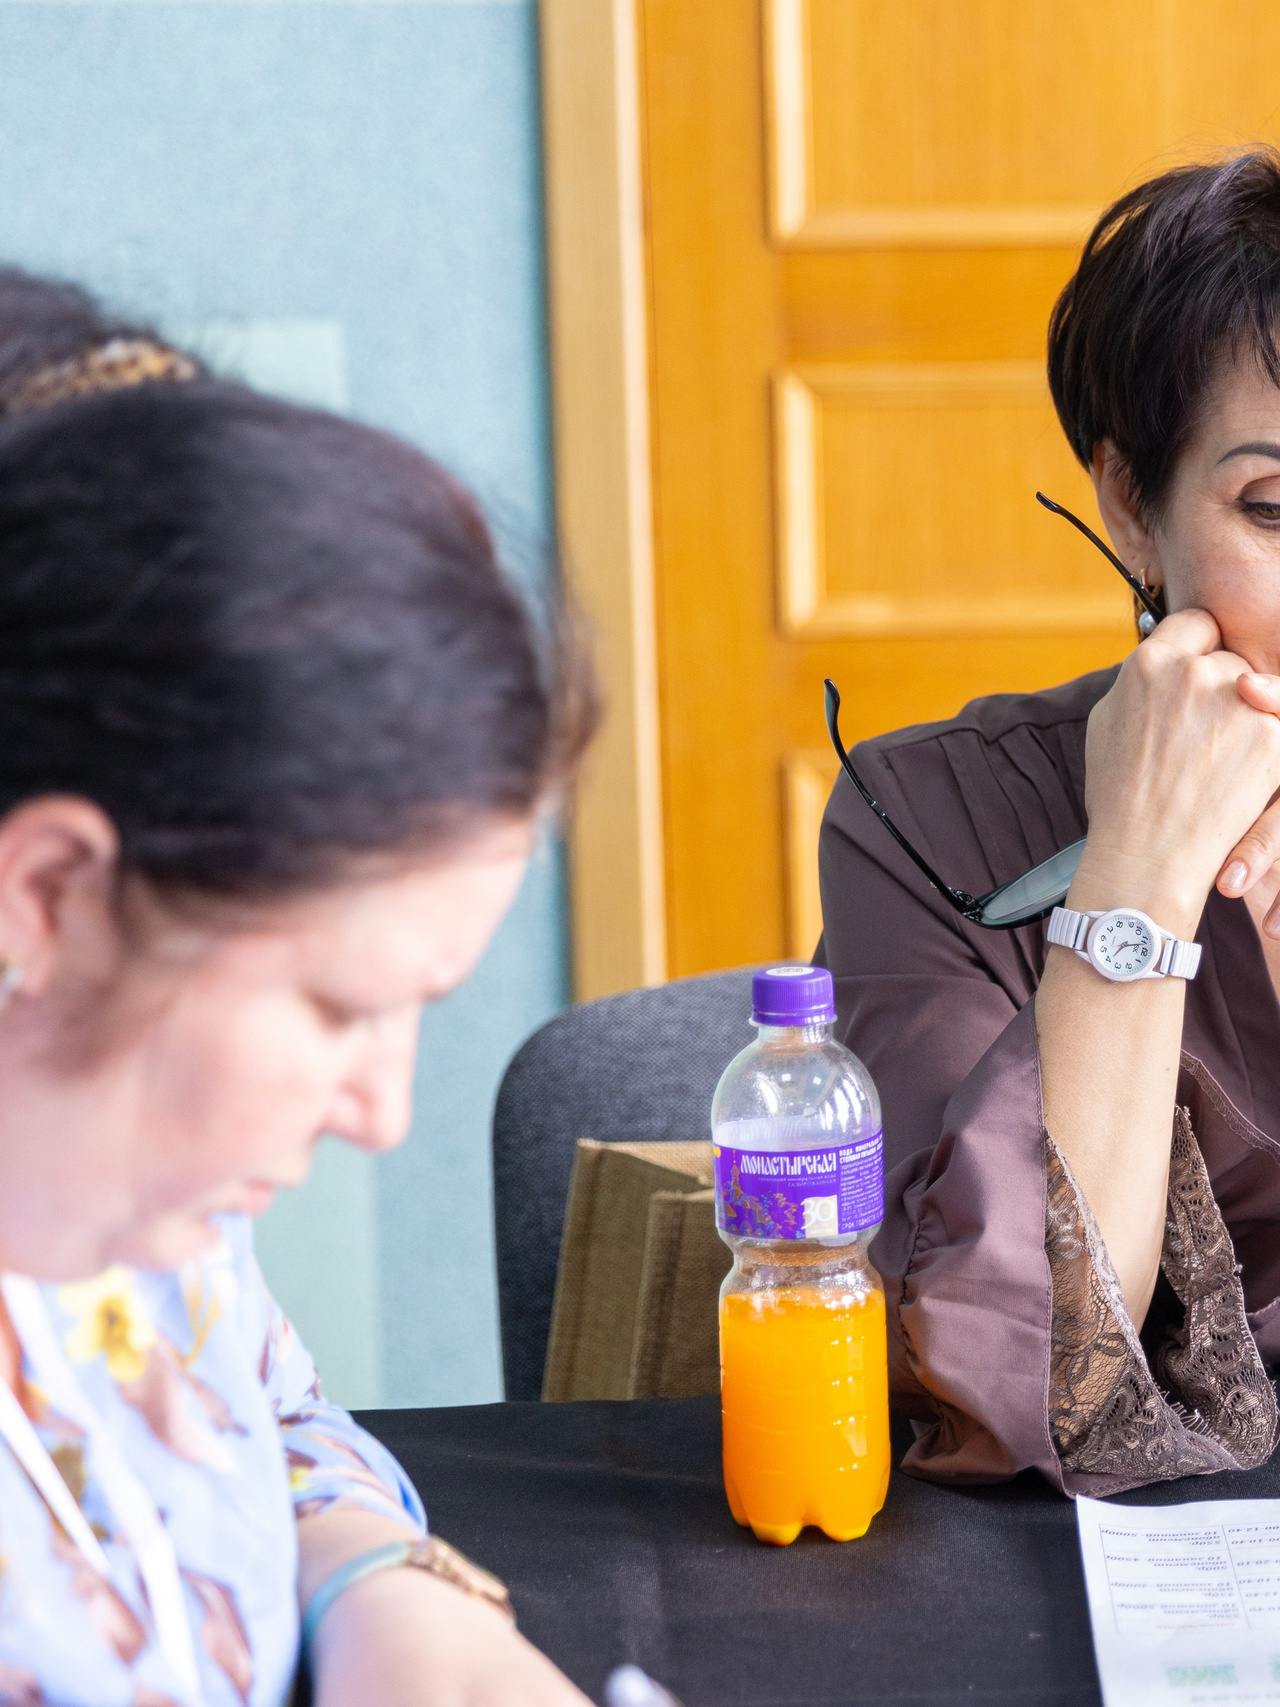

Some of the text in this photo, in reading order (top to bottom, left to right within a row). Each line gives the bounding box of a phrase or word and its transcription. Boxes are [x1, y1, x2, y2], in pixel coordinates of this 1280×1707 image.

[741, 1152, 837, 1175] МОНАСТЫРСКАЯ
[787, 1178, 837, 1187] ГАЗИРОВАННАЯ
[800, 1199, 836, 1229] 30
